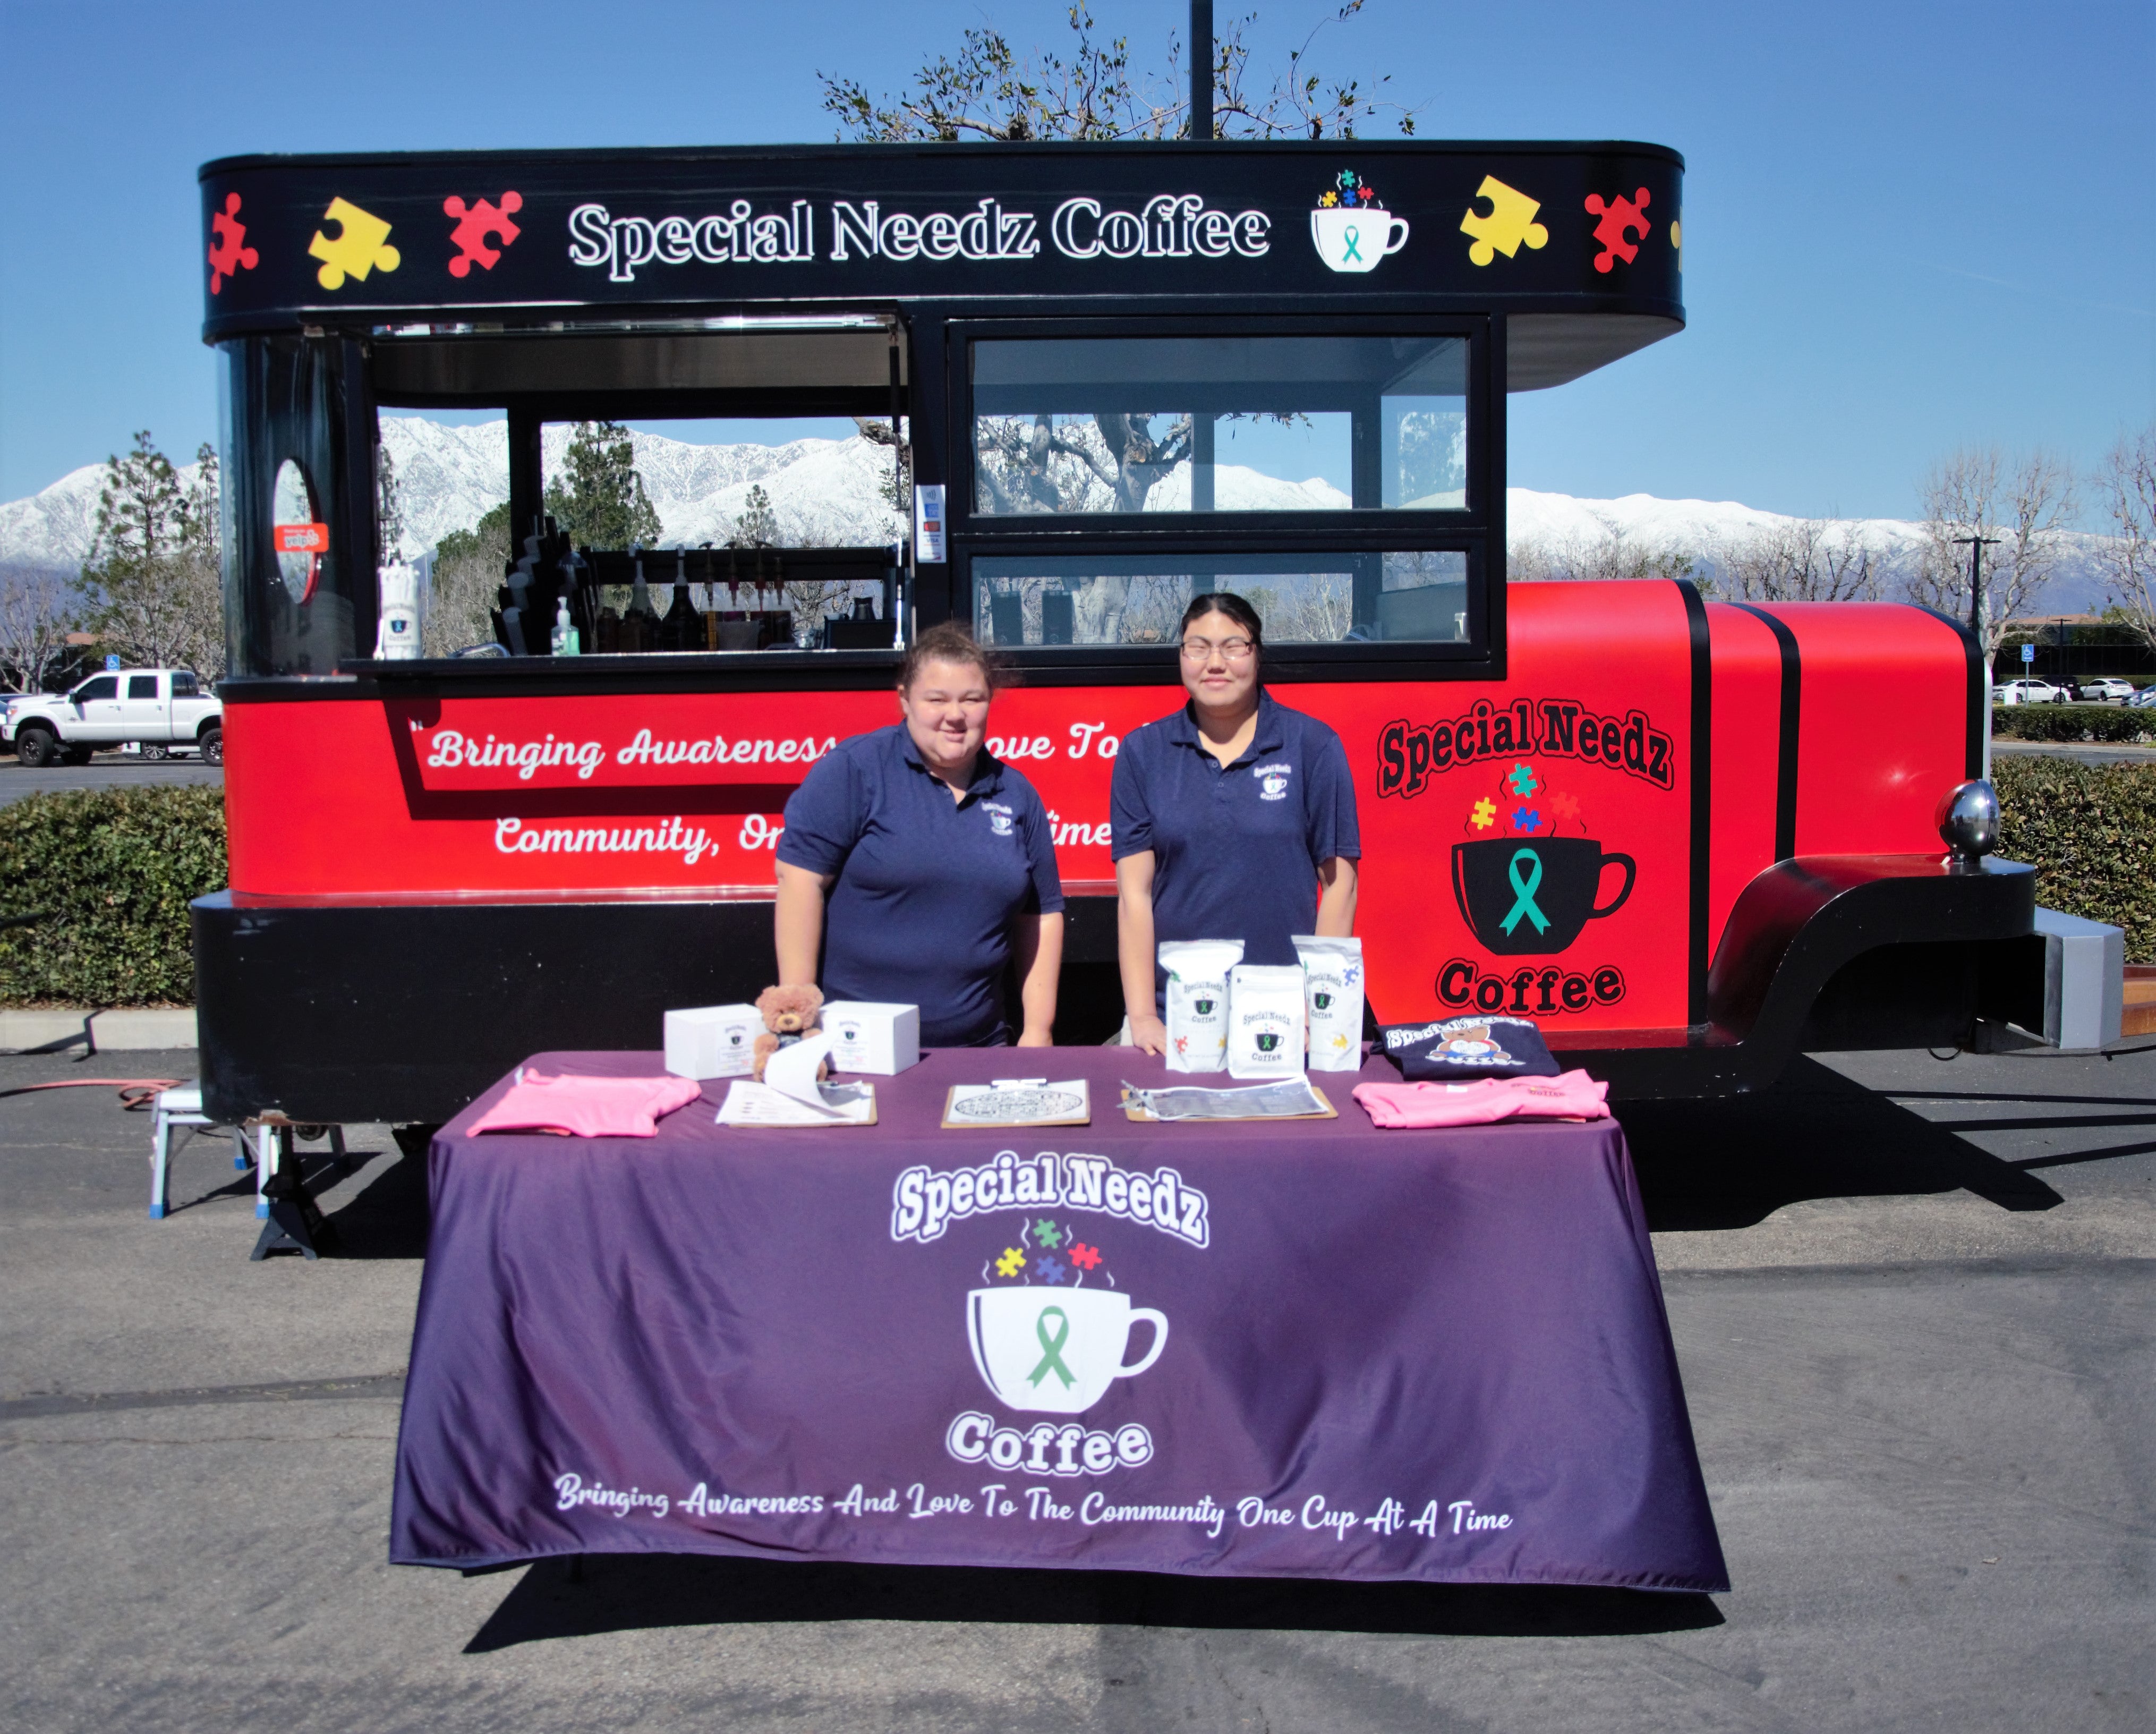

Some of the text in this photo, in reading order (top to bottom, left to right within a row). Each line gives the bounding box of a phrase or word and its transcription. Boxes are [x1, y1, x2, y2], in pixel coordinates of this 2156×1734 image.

[568, 194, 1271, 282] Special Needz Coffee
[285, 533, 307, 549] yelp
[985, 736, 1055, 760] ove
[1068, 721, 1119, 760] To
[1380, 703, 1670, 793] Special Needz
[495, 809, 1112, 865] Community, On ime
[1438, 959, 1623, 1012] Coffee
[1243, 1011, 1290, 1025] Special Needz
[1311, 1010, 1332, 1019] Coffee
[1251, 1053, 1282, 1061] Coffee
[893, 1152, 1207, 1246] Special Needz
[949, 1414, 1151, 1474] Coffee
[554, 1472, 1513, 1541] Bringing Awareness And Love To The Community One Cup At A Time
